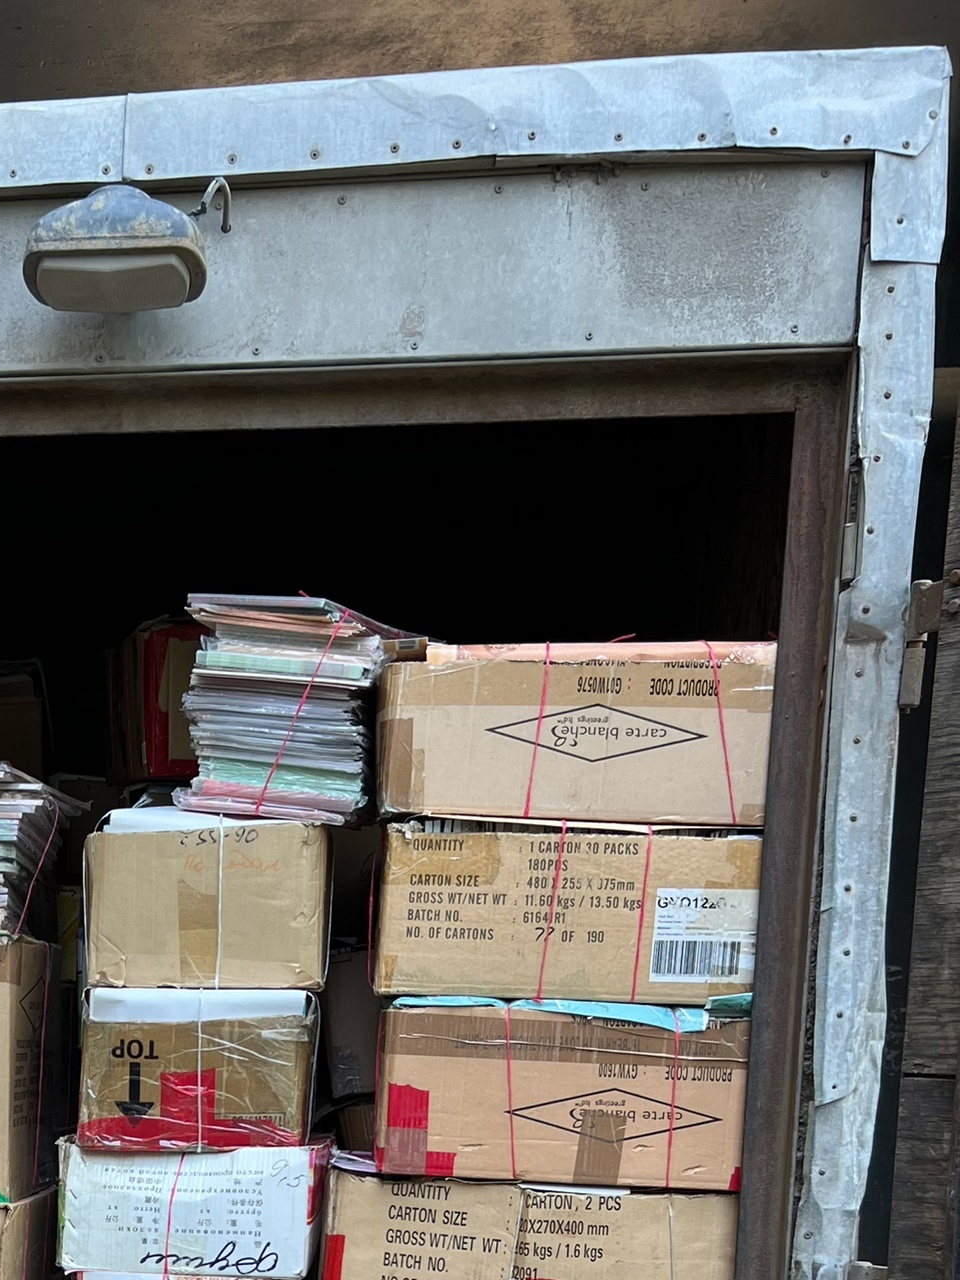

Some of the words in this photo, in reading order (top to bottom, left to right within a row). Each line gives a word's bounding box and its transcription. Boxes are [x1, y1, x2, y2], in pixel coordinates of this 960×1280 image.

[649, 678, 673, 695] CODE
[560, 725, 619, 740] blanche
[626, 728, 667, 738] carte
[413, 839, 465, 852] QUANTITY
[538, 842, 581, 854] CARTON
[603, 843, 639, 855] PACKS
[409, 874, 451, 887] CARTON
[456, 875, 479, 888] SIZE
[527, 877, 548, 889] 480
[561, 877, 582, 890] 255
[409, 893, 443, 905] GROSS
[447, 893, 489, 906] WT/NET
[492, 894, 507, 906] WT
[524, 894, 552, 907] 11.60
[556, 895, 576, 911] kgs
[589, 896, 619, 909] 13.50
[623, 896, 642, 912] kgs
[407, 909, 441, 922] BATCH
[444, 911, 463, 923] NO.
[406, 926, 424, 939] NO.
[428, 928, 442, 940] OF
[445, 928, 494, 941] CARTONS
[561, 931, 575, 943] OF
[586, 931, 605, 943] 190
[111, 1039, 159, 1060] TOP
[598, 1062, 638, 1080] GYW1600
[664, 1063, 689, 1081] CODE
[689, 1065, 733, 1083] PRODUCT
[642, 1110, 683, 1121] carte
[391, 1184, 451, 1201] QUANTITY
[585, 1196, 592, 1211] 2
[598, 1195, 622, 1212] PCS
[388, 1205, 437, 1224] CARTON
[442, 1209, 468, 1227] SIZE
[586, 1222, 610, 1236] mm
[385, 1228, 426, 1247] GROSS
[429, 1232, 476, 1252] WT/NET
[482, 1237, 502, 1254] WT
[532, 1242, 553, 1260] kgs
[565, 1243, 581, 1259] 1.6
[583, 1243, 604, 1262] kgs
[383, 1251, 422, 1271] BATCH
[427, 1256, 449, 1273] NO.
